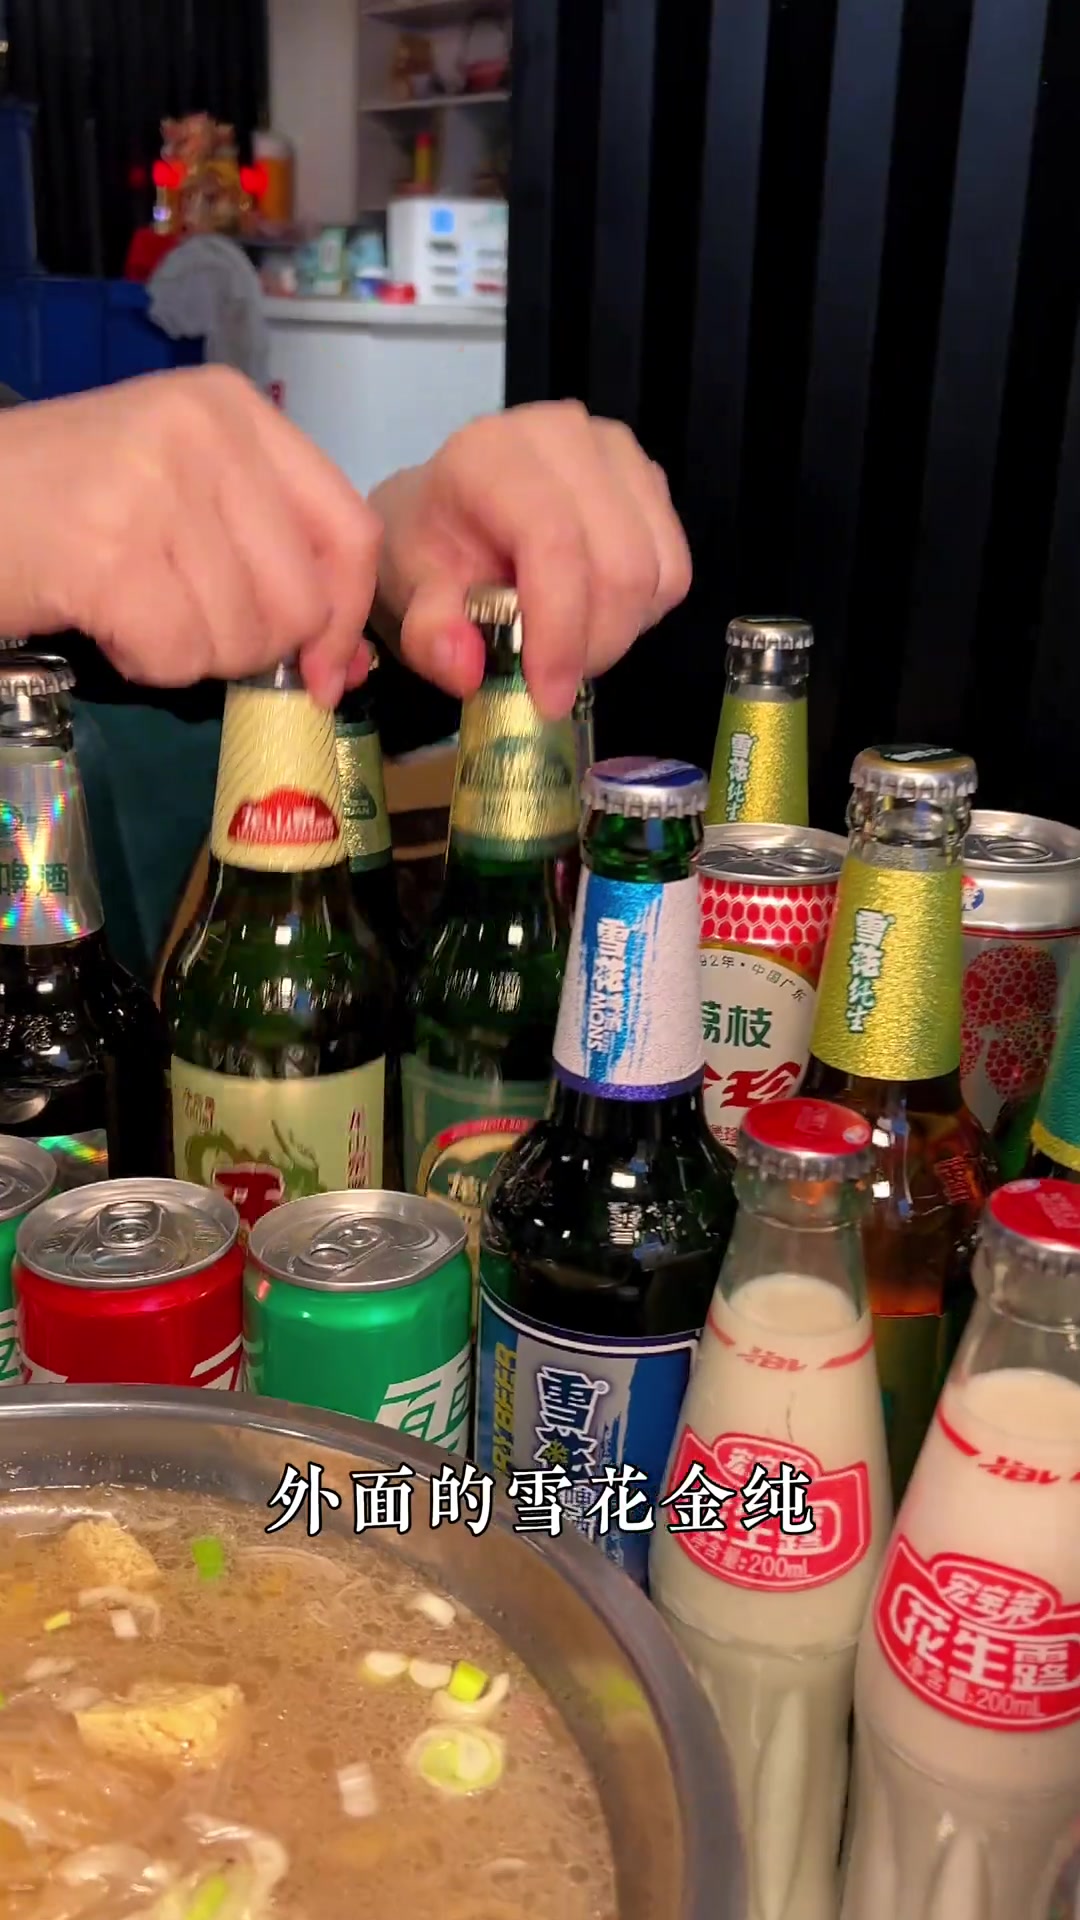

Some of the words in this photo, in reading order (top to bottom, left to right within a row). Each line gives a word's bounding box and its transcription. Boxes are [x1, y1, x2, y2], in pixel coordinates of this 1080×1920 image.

[585, 990, 605, 1052] SNOW
[901, 1597, 1069, 1692] 花生露
